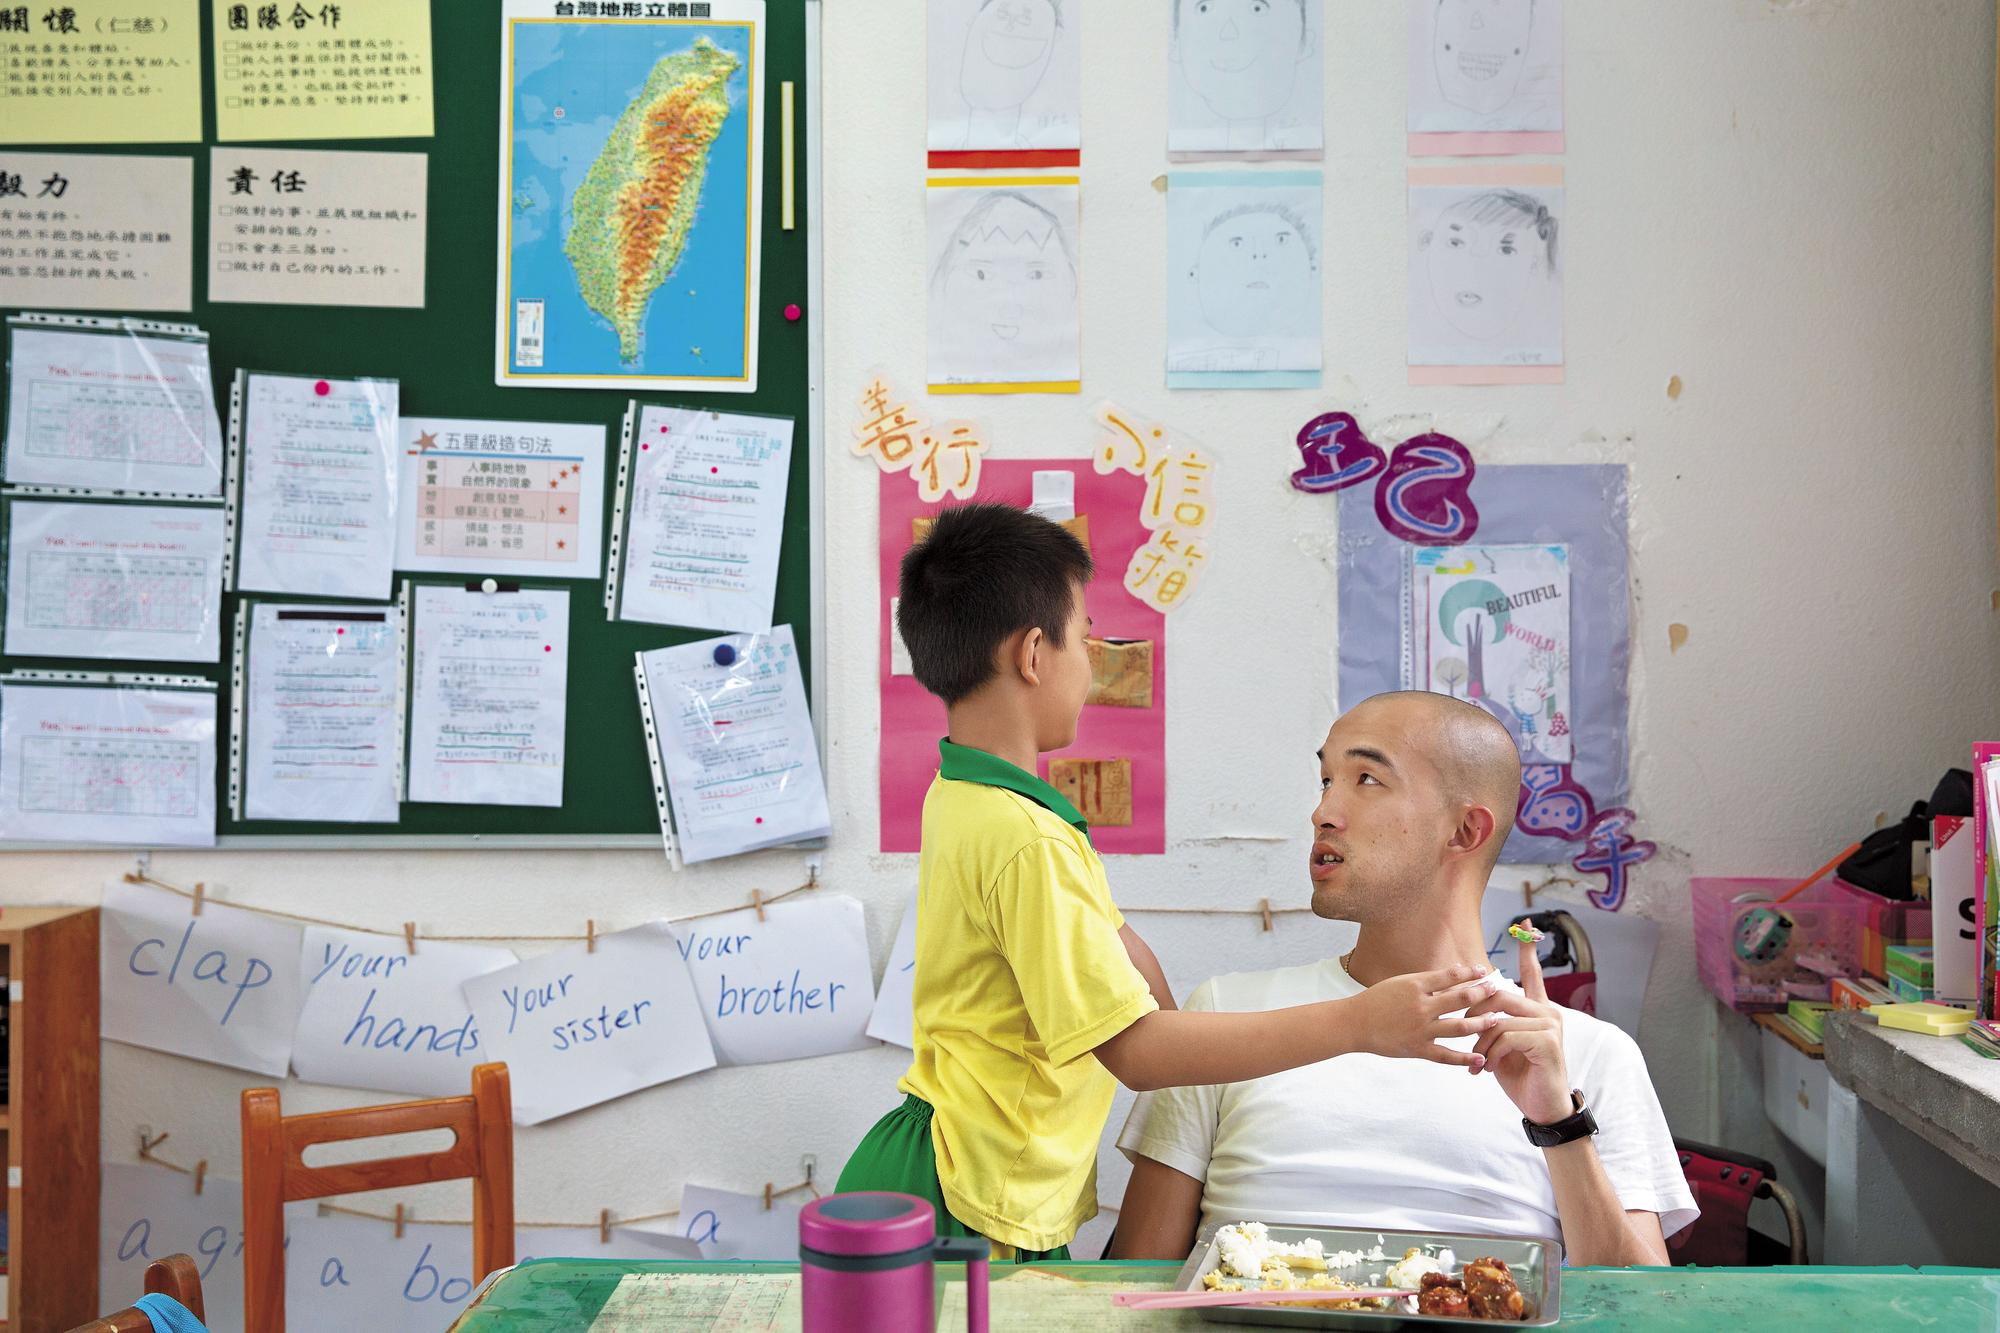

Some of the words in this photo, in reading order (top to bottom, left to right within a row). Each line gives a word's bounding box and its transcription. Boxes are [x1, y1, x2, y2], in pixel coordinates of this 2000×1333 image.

[228, 3, 341, 31] 團隊合作
[555, 1, 711, 18] 台灣地形立體圖
[227, 165, 307, 195] 責任
[444, 432, 553, 454] 五星級造句法
[1485, 584, 1562, 616] BEAUTIFUL
[1503, 621, 1556, 652] WORLD
[676, 932, 752, 962] your
[129, 920, 273, 1026] clap
[312, 942, 408, 985] your
[502, 973, 574, 1034] your
[717, 968, 846, 1020] brother
[343, 988, 480, 1057] hands
[552, 999, 652, 1051] sister
[117, 1217, 152, 1262] a
[319, 1257, 351, 1288] a
